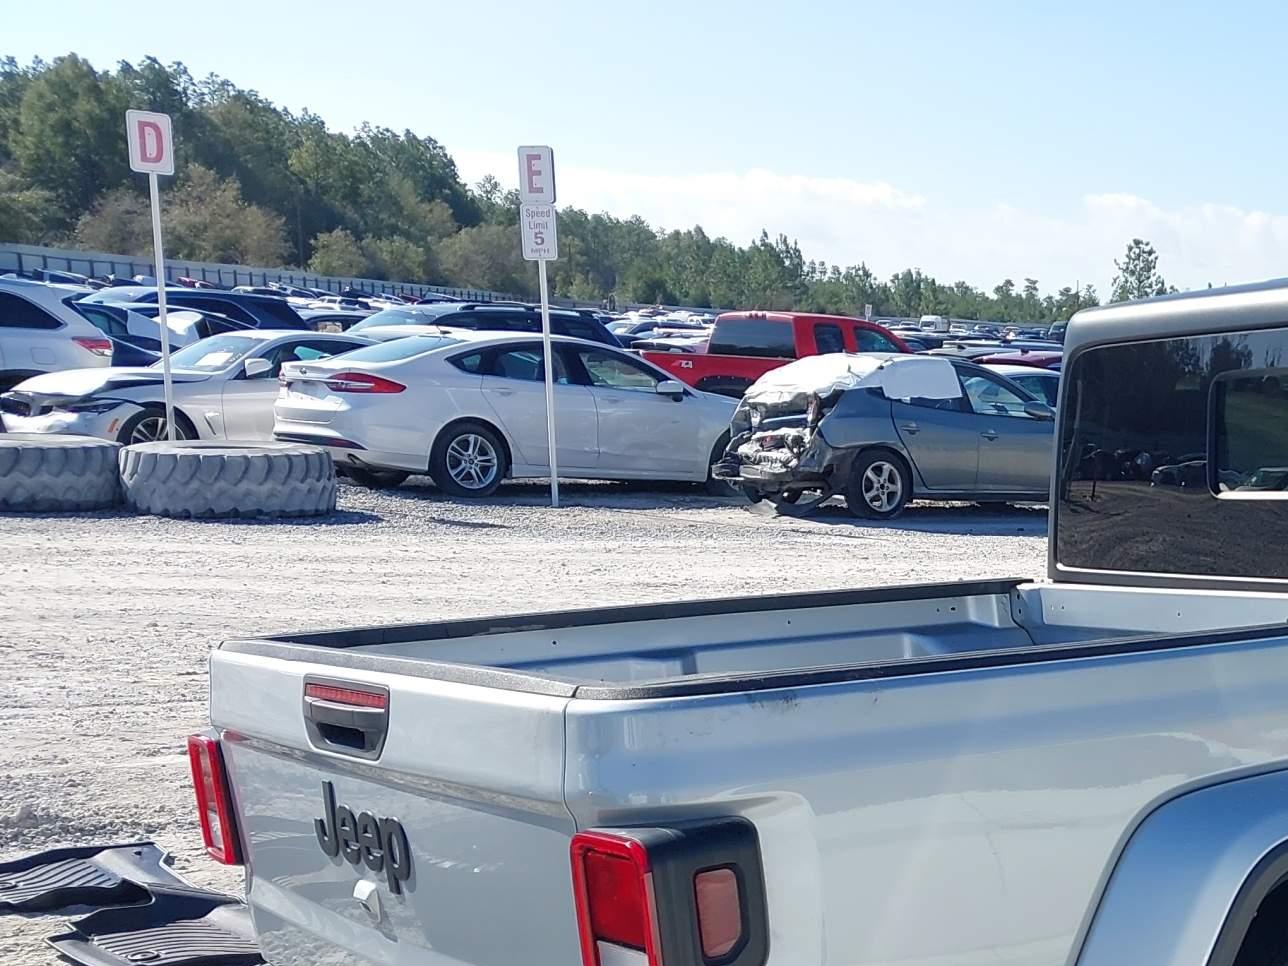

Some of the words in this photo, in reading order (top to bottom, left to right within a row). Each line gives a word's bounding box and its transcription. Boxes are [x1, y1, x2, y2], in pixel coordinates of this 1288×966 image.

[137, 120, 164, 164] D
[526, 153, 545, 194] E
[525, 208, 551, 219] Speed
[528, 220, 549, 230] Limit
[534, 231, 545, 246] 5
[313, 780, 412, 895] Jeep
